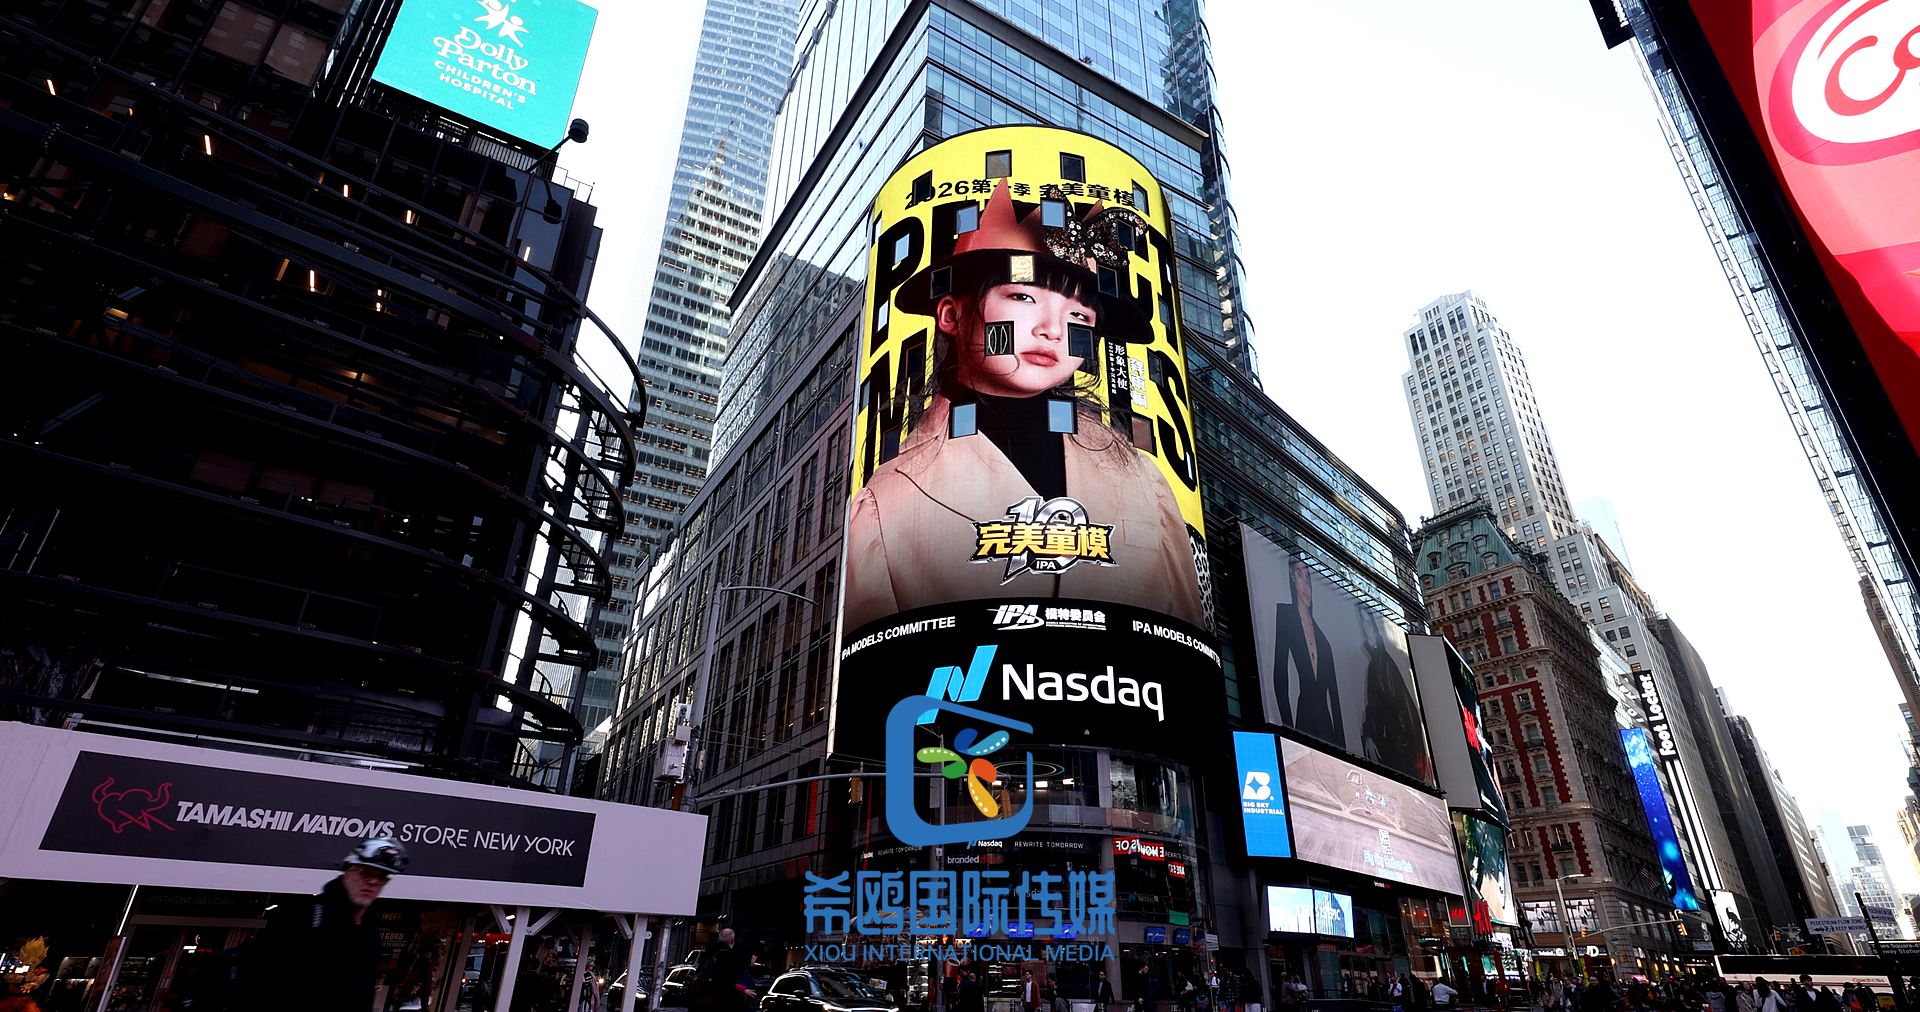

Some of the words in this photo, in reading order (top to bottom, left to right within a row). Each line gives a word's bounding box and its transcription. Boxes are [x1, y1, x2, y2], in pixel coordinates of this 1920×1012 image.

[433, 36, 537, 96] Parton
[454, 25, 529, 71] Dolly
[434, 60, 527, 104] CHILDREN'S
[439, 73, 515, 110] HOSPITAL
[1114, 344, 1128, 391] 形象大使
[977, 522, 1109, 559] 完美童模
[1036, 560, 1056, 570] IPA
[992, 604, 1039, 624] IPA
[851, 631, 884, 654] MODELS
[884, 616, 956, 640] COMMITTEE
[1132, 620, 1152, 635] IPA
[1153, 624, 1193, 647] MODELS
[1002, 664, 1165, 722] Nasdaq
[1639, 673, 1665, 722] Locker
[1653, 723, 1677, 756] Foot
[176, 801, 292, 832] TAMASHII
[293, 813, 395, 840] NATIONS
[400, 824, 469, 850] STORE
[473, 831, 521, 852] NEW
[523, 835, 577, 857] YORK
[1243, 807, 1285, 815] INDUSTRIAL
[947, 855, 980, 864] branded
[977, 840, 1003, 848] Nasdaq
[1046, 841, 1084, 849] TOMORROW
